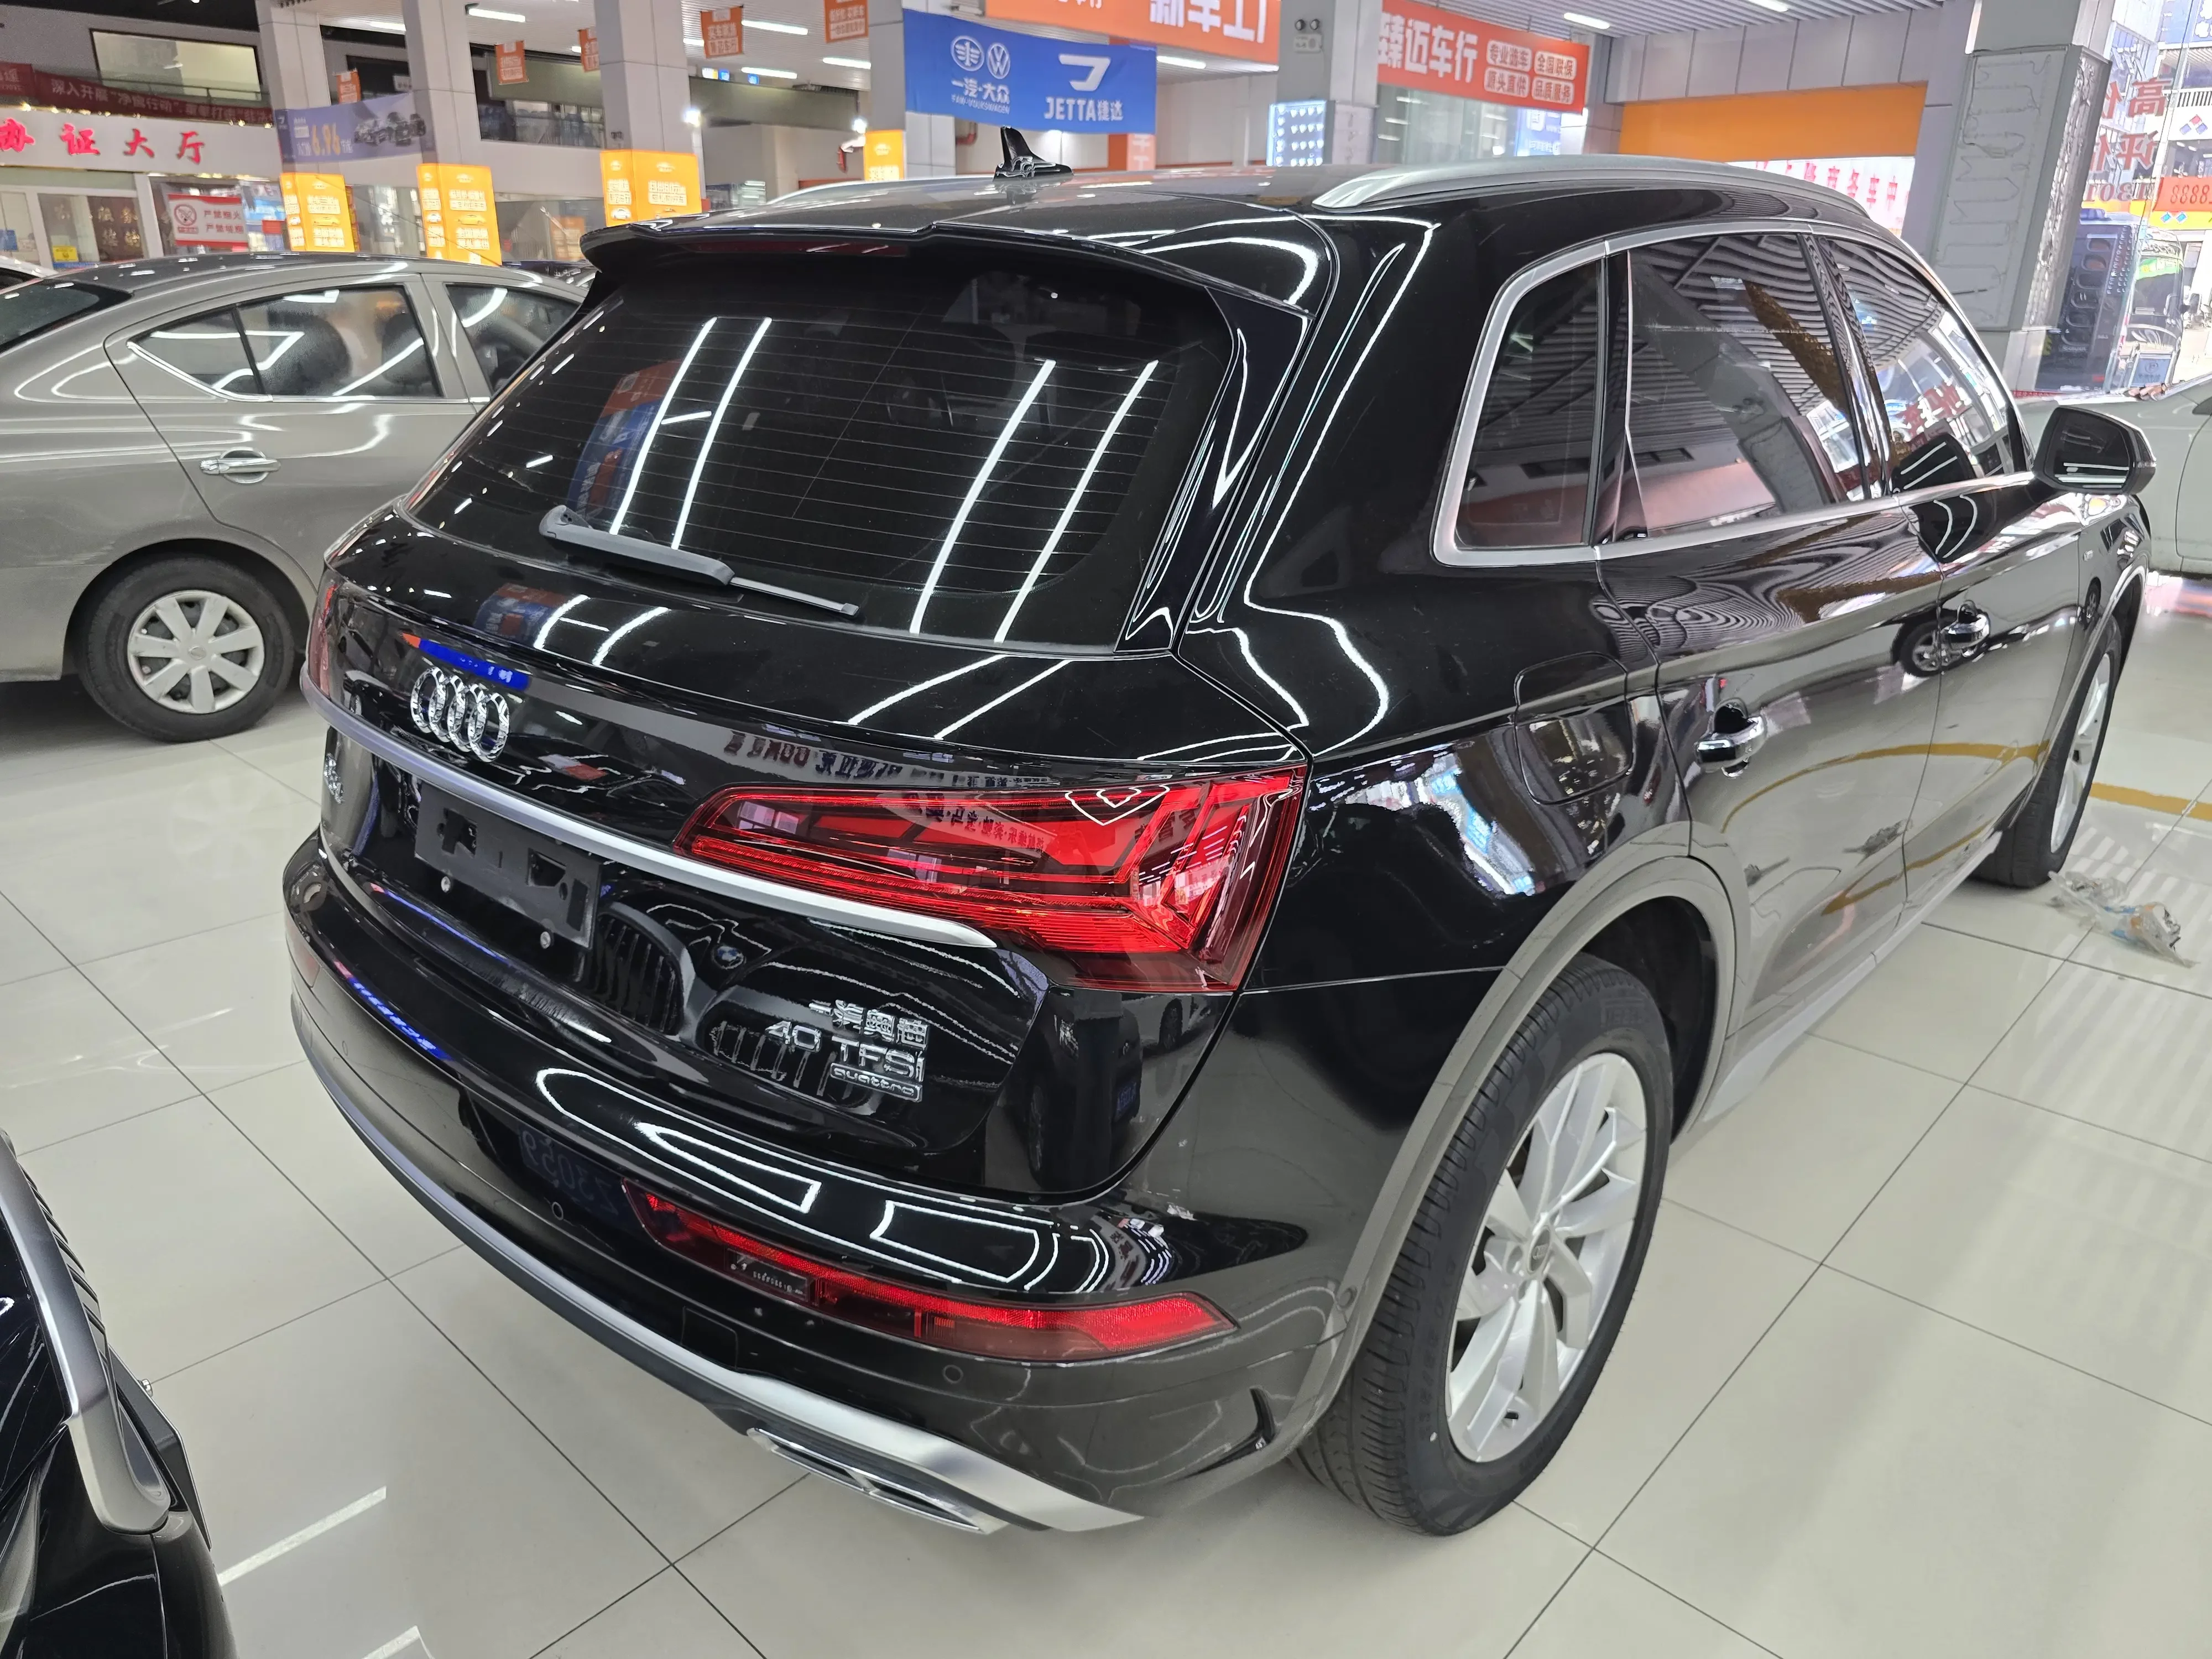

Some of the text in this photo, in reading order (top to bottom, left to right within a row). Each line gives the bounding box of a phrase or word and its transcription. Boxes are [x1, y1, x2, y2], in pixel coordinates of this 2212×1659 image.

[951, 77, 1010, 105] 一汽·大众
[765, 1020, 925, 1082] 40 TFSI
[833, 1067, 916, 1097] quattro
